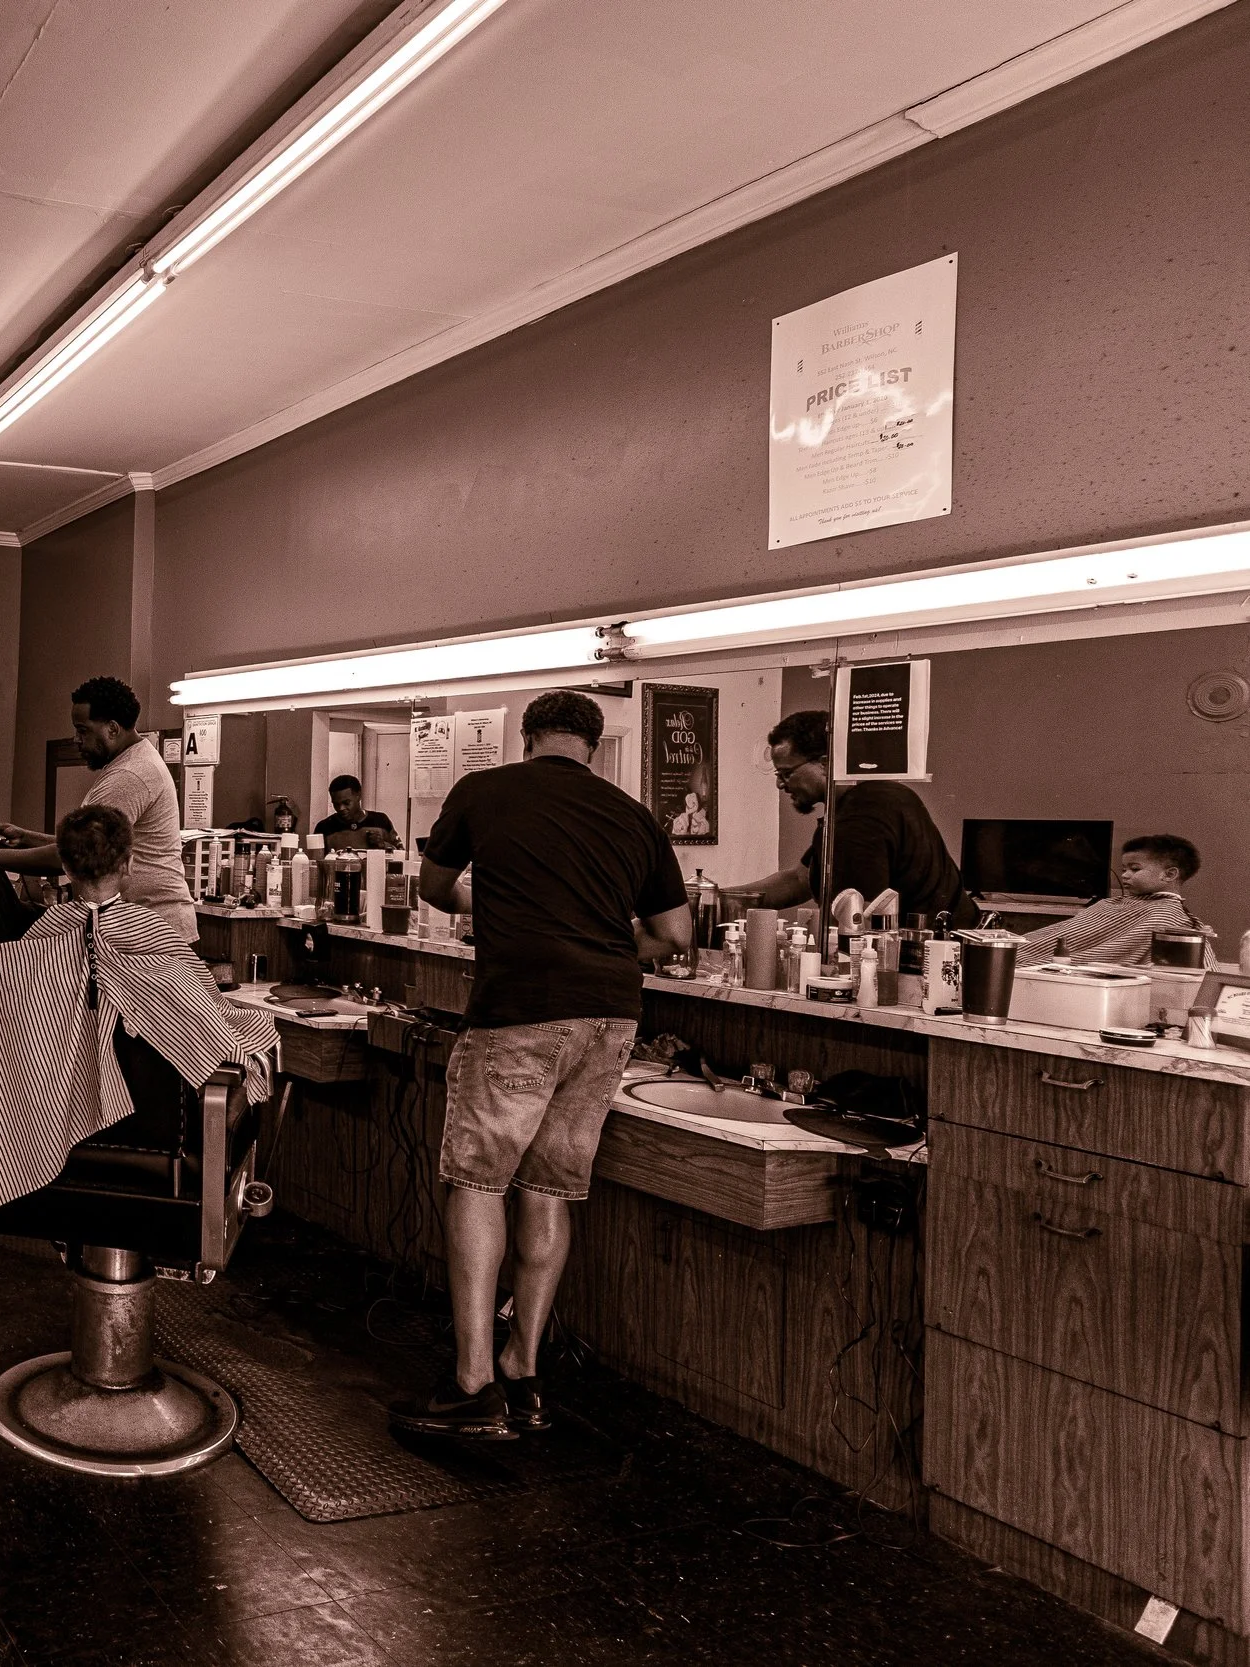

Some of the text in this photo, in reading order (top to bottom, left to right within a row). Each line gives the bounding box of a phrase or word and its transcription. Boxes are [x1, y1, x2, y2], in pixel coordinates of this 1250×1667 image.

[833, 322, 869, 337] Williams
[828, 365, 838, 373] East
[806, 367, 912, 413] PRICE LIST
[840, 402, 864, 413] January
[811, 451, 823, 459] Men
[825, 446, 844, 456] Regular
[822, 456, 846, 466] including
[848, 451, 864, 460] Temp
[804, 472, 816, 480] Men
[817, 469, 830, 477] Edge
[846, 461, 863, 469] Beard
[823, 477, 835, 485] Men
[836, 474, 849, 482] Edge
[799, 506, 840, 520] APPOINTMENTS
[872, 495, 890, 503] YOUR
[893, 489, 918, 499] SERVICE
[852, 510, 871, 518] visiting
[186, 732, 198, 756] A
